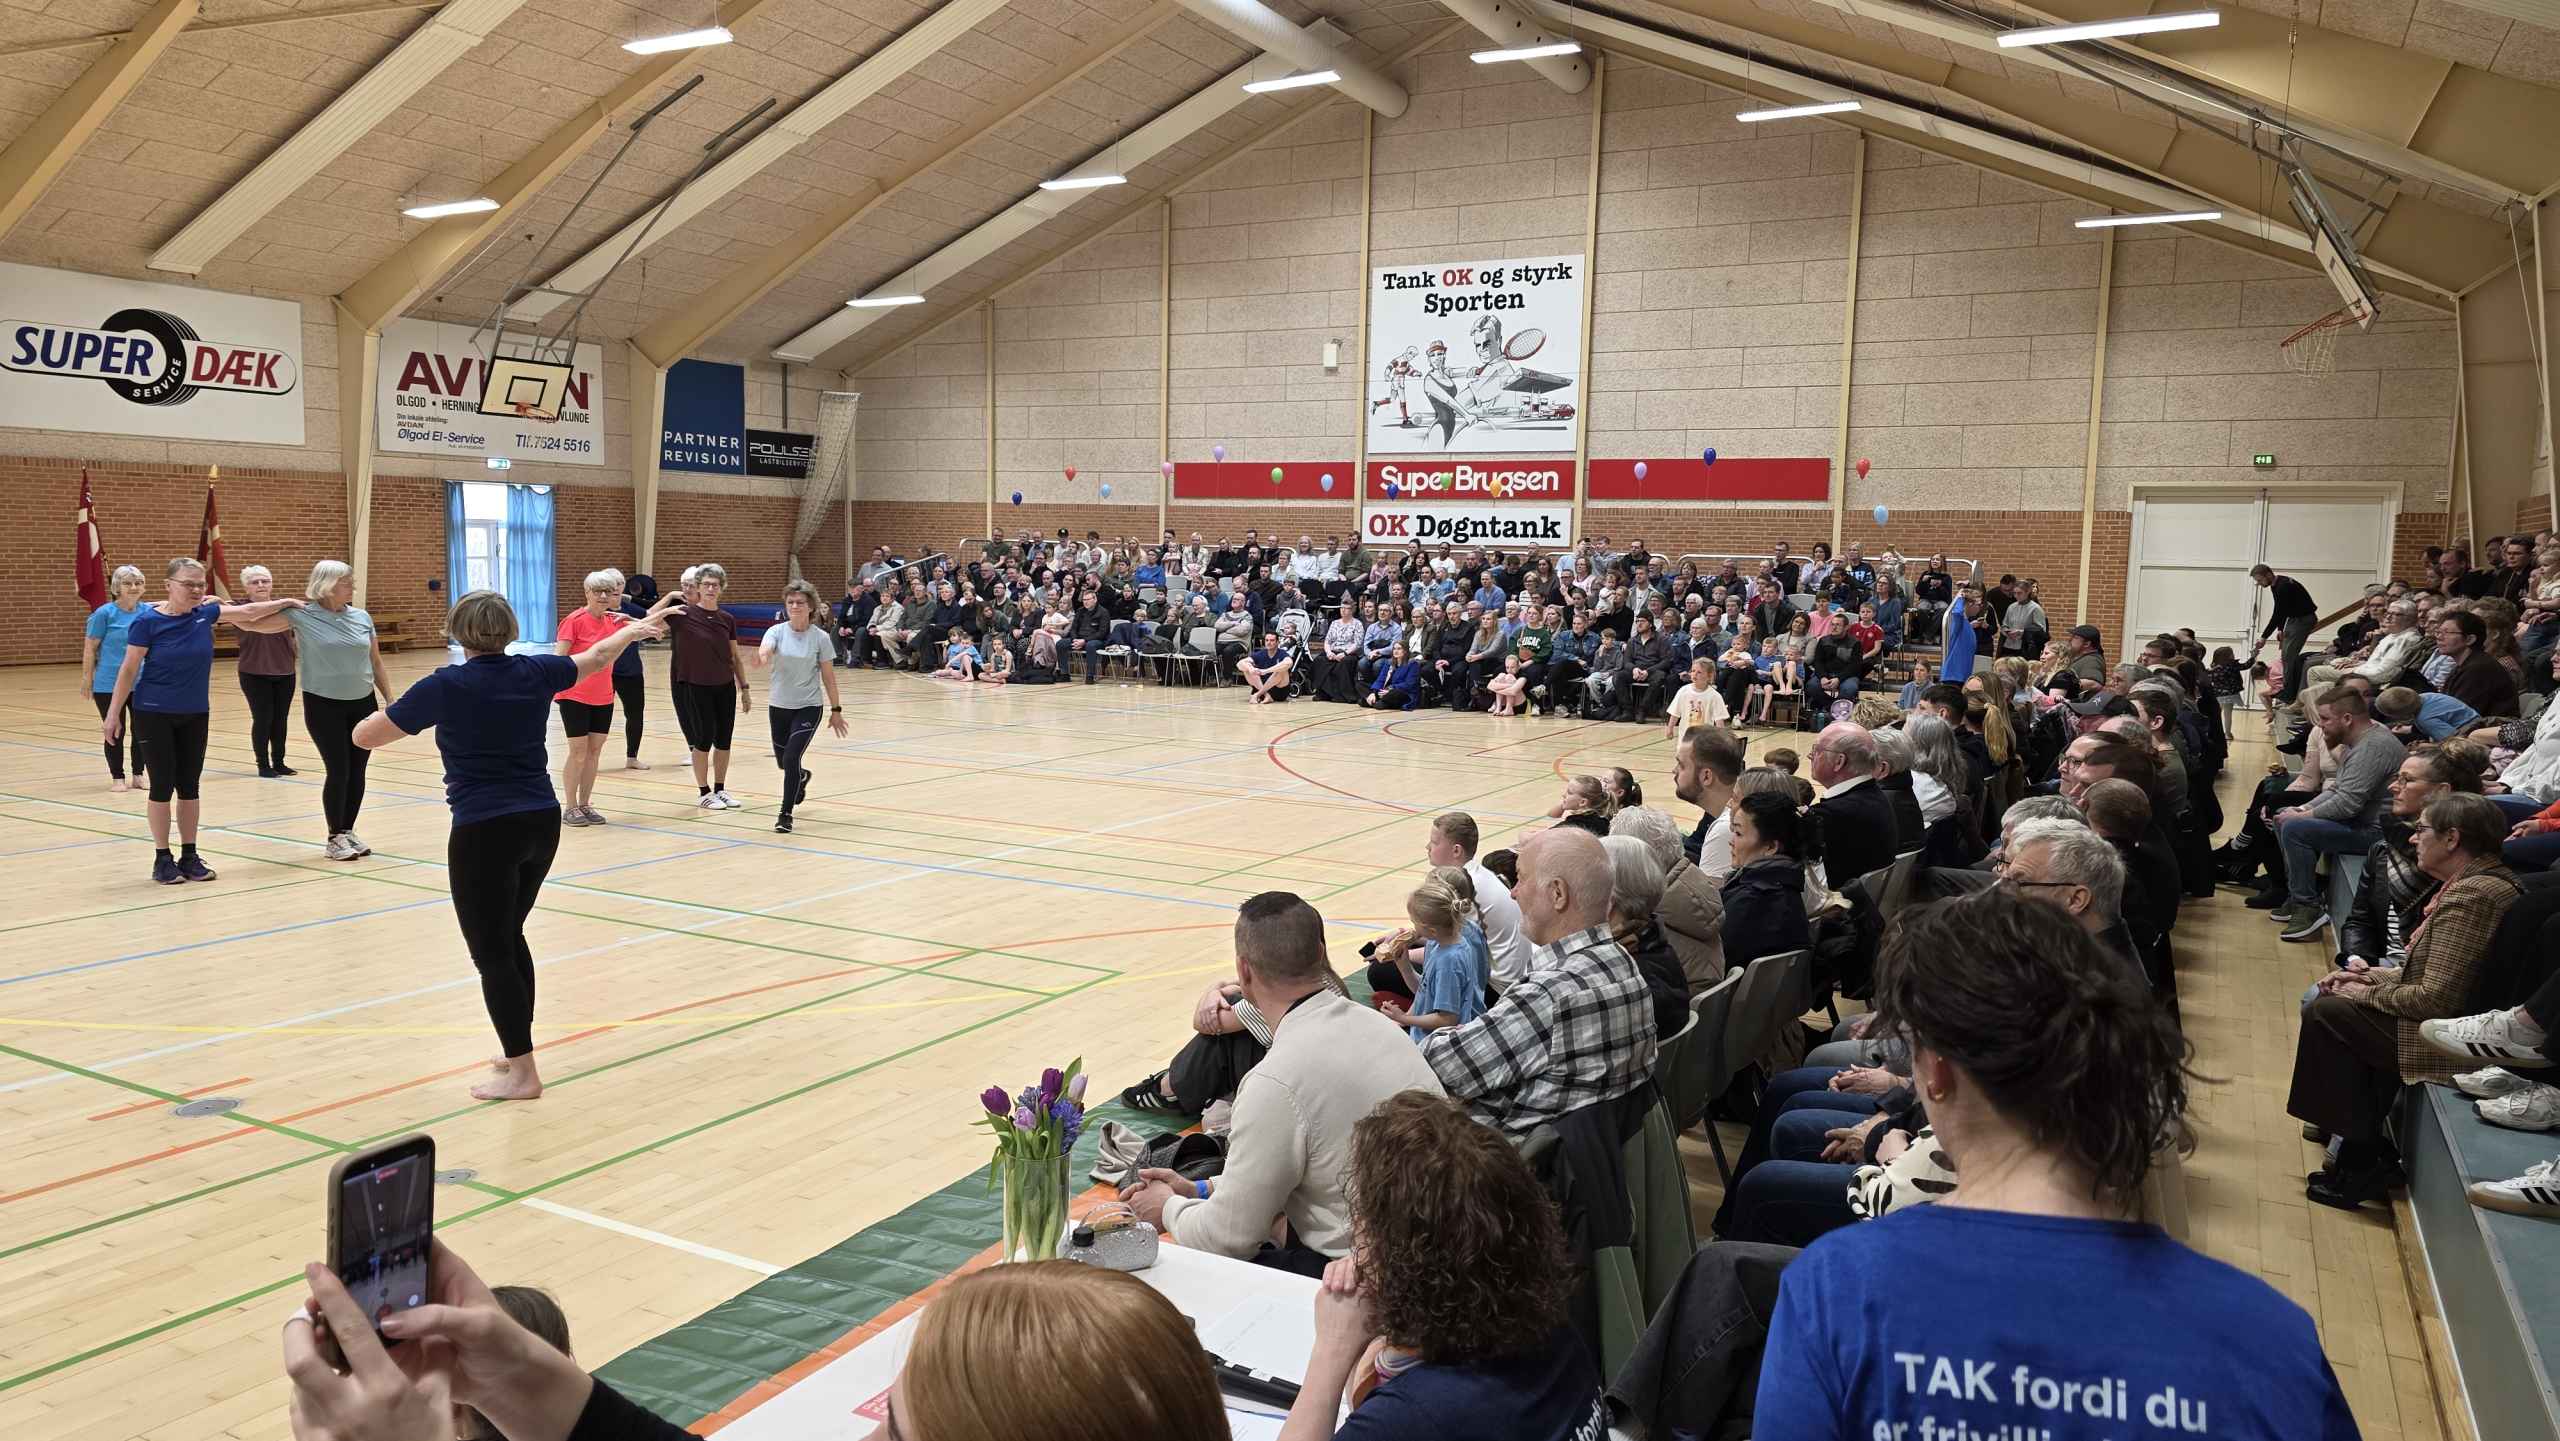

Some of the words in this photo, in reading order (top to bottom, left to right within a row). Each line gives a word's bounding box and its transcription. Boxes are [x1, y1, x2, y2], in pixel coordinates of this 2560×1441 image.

[1383, 271, 1436, 290] Tank
[1442, 268, 1475, 287] OK
[1479, 267, 1505, 289] og
[1511, 262, 1573, 286] styrk
[1423, 290, 1526, 318] Sporten
[11, 325, 154, 377] SUPER
[191, 345, 282, 389] DÆK
[133, 357, 183, 398] SERVICE
[441, 398, 480, 413] HERNING
[398, 428, 430, 442] Ølgod
[563, 438, 591, 453] 5516
[664, 431, 740, 449] PARTNER
[664, 449, 740, 467] REVISION
[1368, 514, 1410, 537] OK
[1415, 514, 1561, 544] Døgntank
[1894, 1352, 1999, 1403] TAK
[2011, 1365, 2127, 1421] fordi
[2145, 1386, 2207, 1434] du
